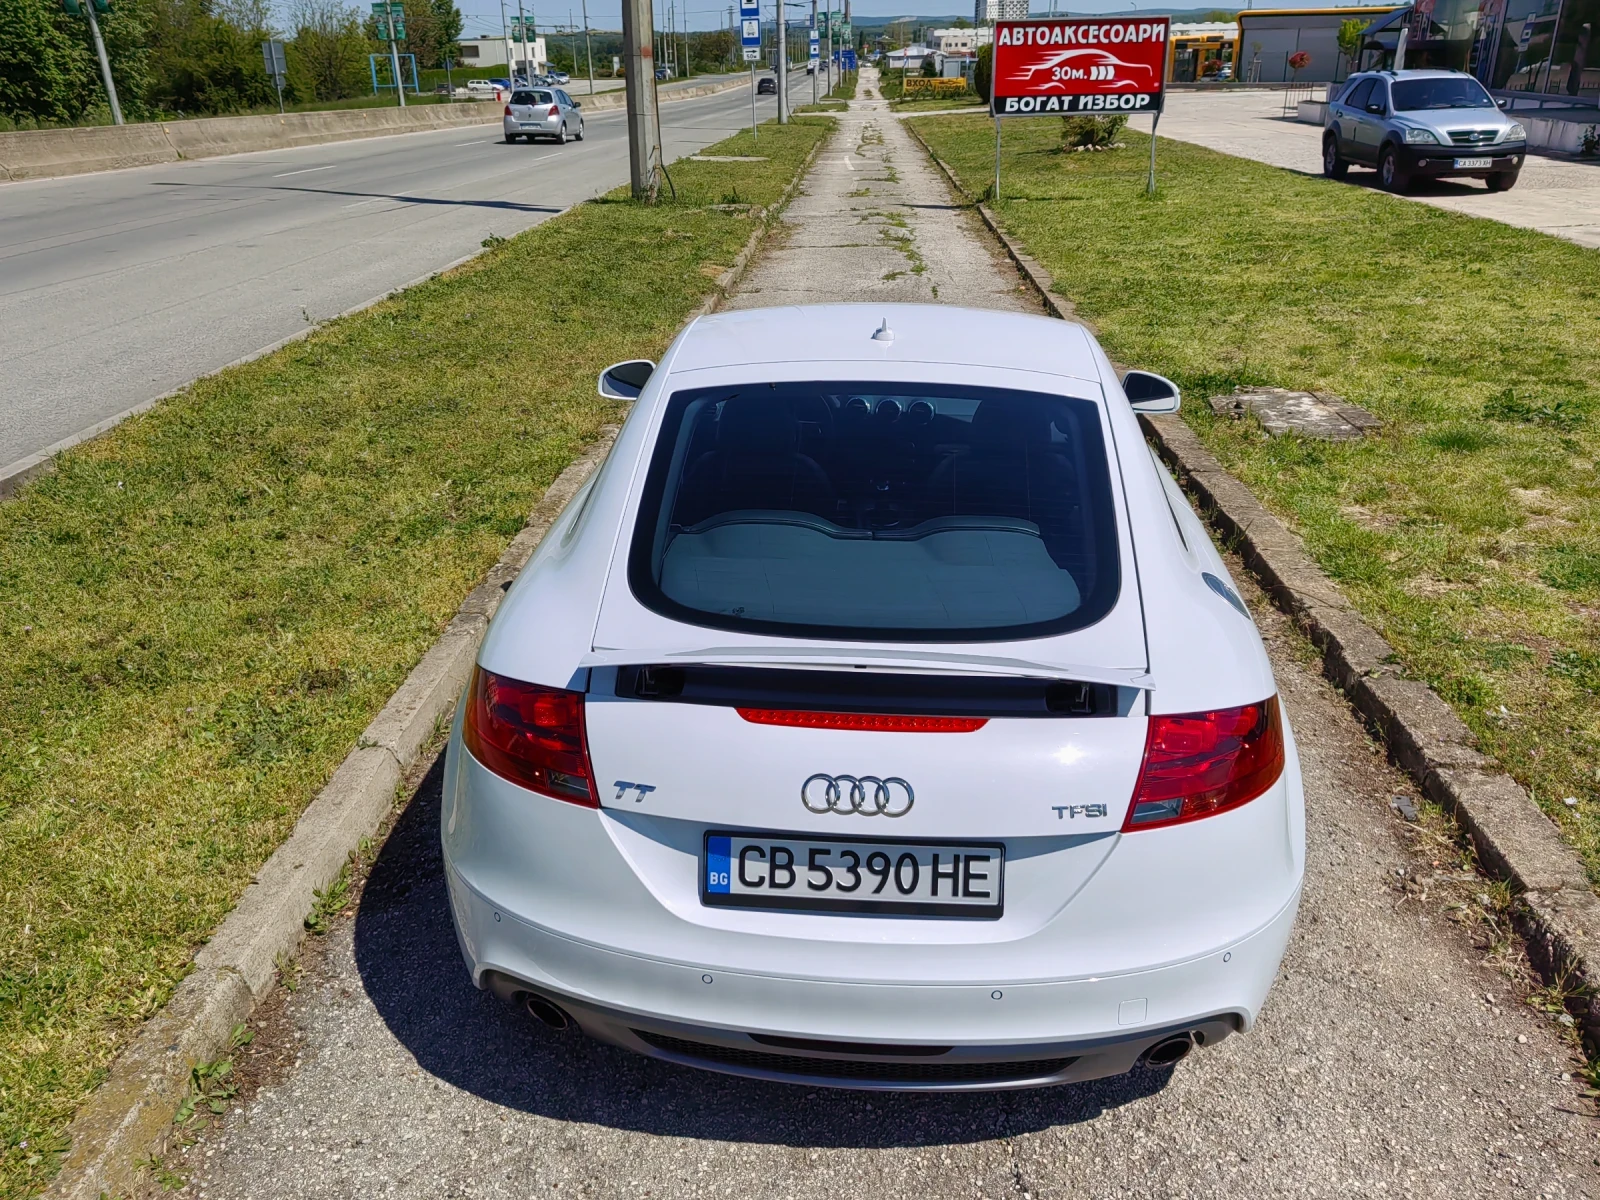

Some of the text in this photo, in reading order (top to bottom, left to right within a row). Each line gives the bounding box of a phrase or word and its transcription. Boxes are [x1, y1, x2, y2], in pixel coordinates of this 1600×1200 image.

[998, 23, 1166, 46] АВТОАКСЕСОАРИ
[1051, 66, 1088, 80] 30м.
[1005, 94, 1150, 112] БОГАТ ИЗБОР
[613, 780, 657, 803] TT
[1051, 803, 1108, 819] TFSI
[710, 871, 728, 885] BG
[738, 845, 991, 898] CB 5390 HE
